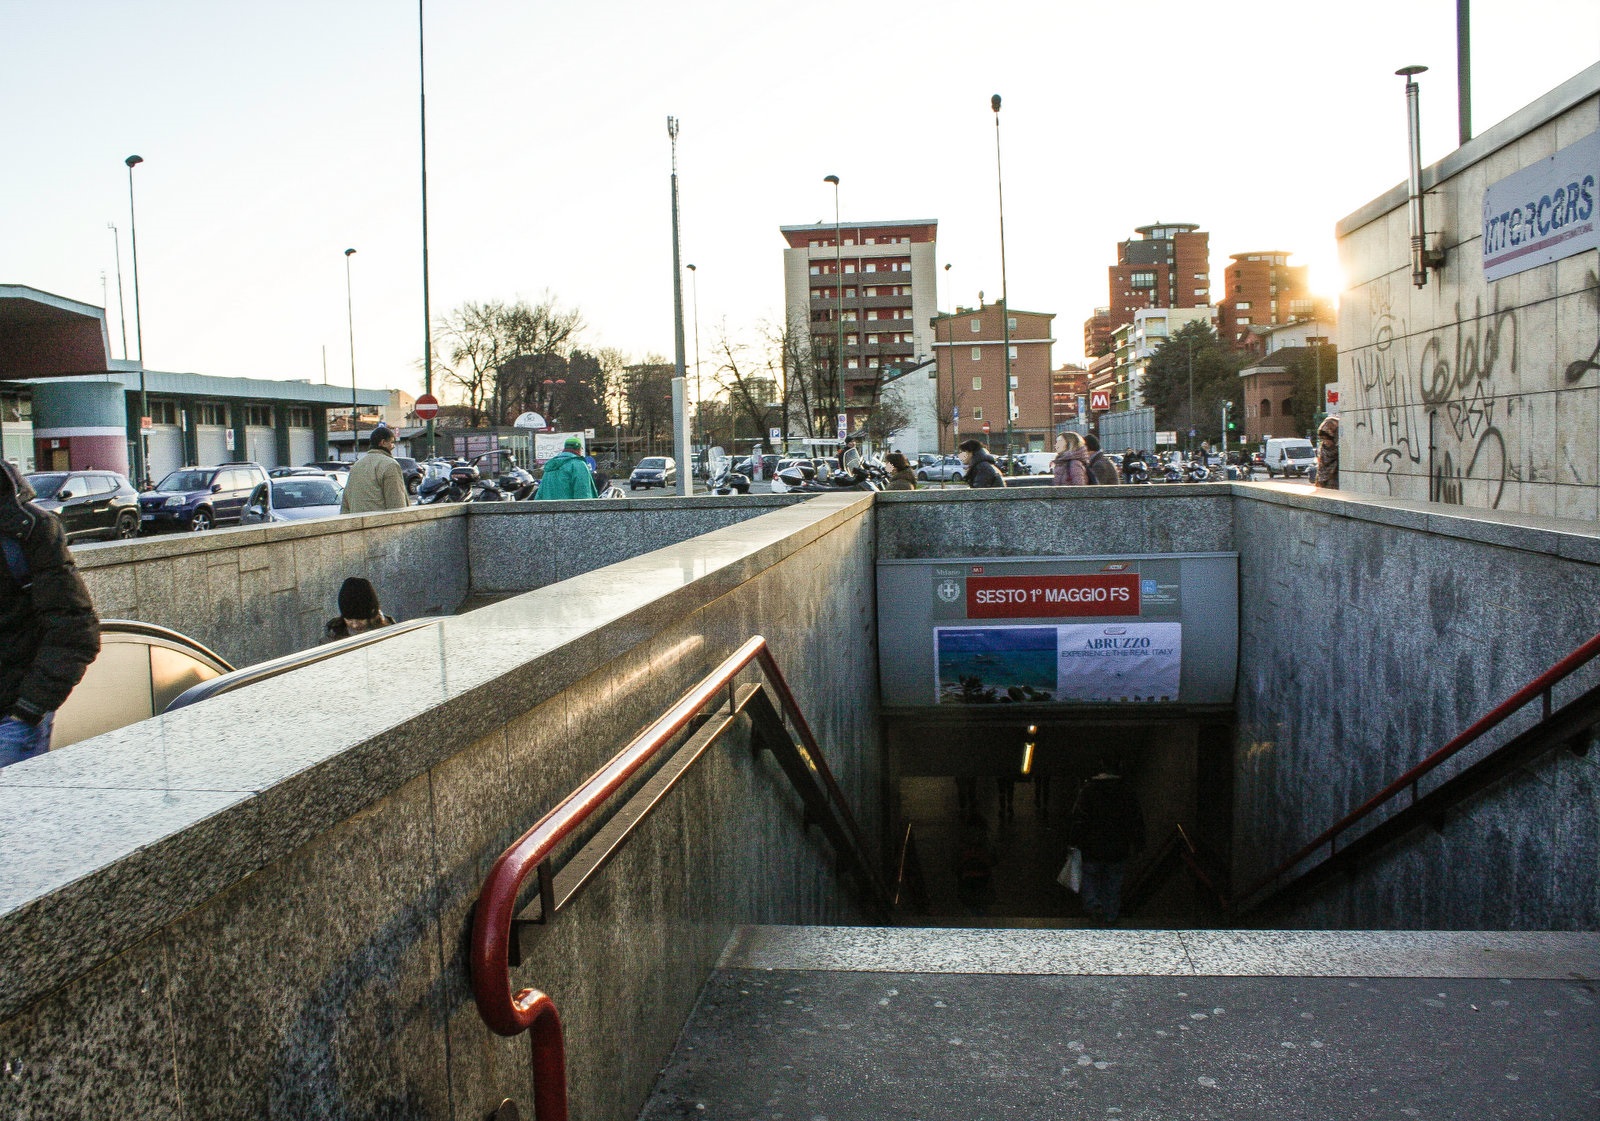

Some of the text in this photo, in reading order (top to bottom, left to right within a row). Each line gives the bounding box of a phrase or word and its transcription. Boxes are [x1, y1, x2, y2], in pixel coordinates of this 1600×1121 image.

[1092, 394, 1108, 406] M
[976, 589, 1027, 604] SESTO
[1045, 587, 1107, 603] MAGGIO
[1110, 587, 1130, 602] FS
[1084, 637, 1151, 650] ABRUZZO
[1061, 649, 1111, 658] EXPERIENCE
[1113, 649, 1129, 657] THE
[1152, 648, 1174, 656] ITALY
